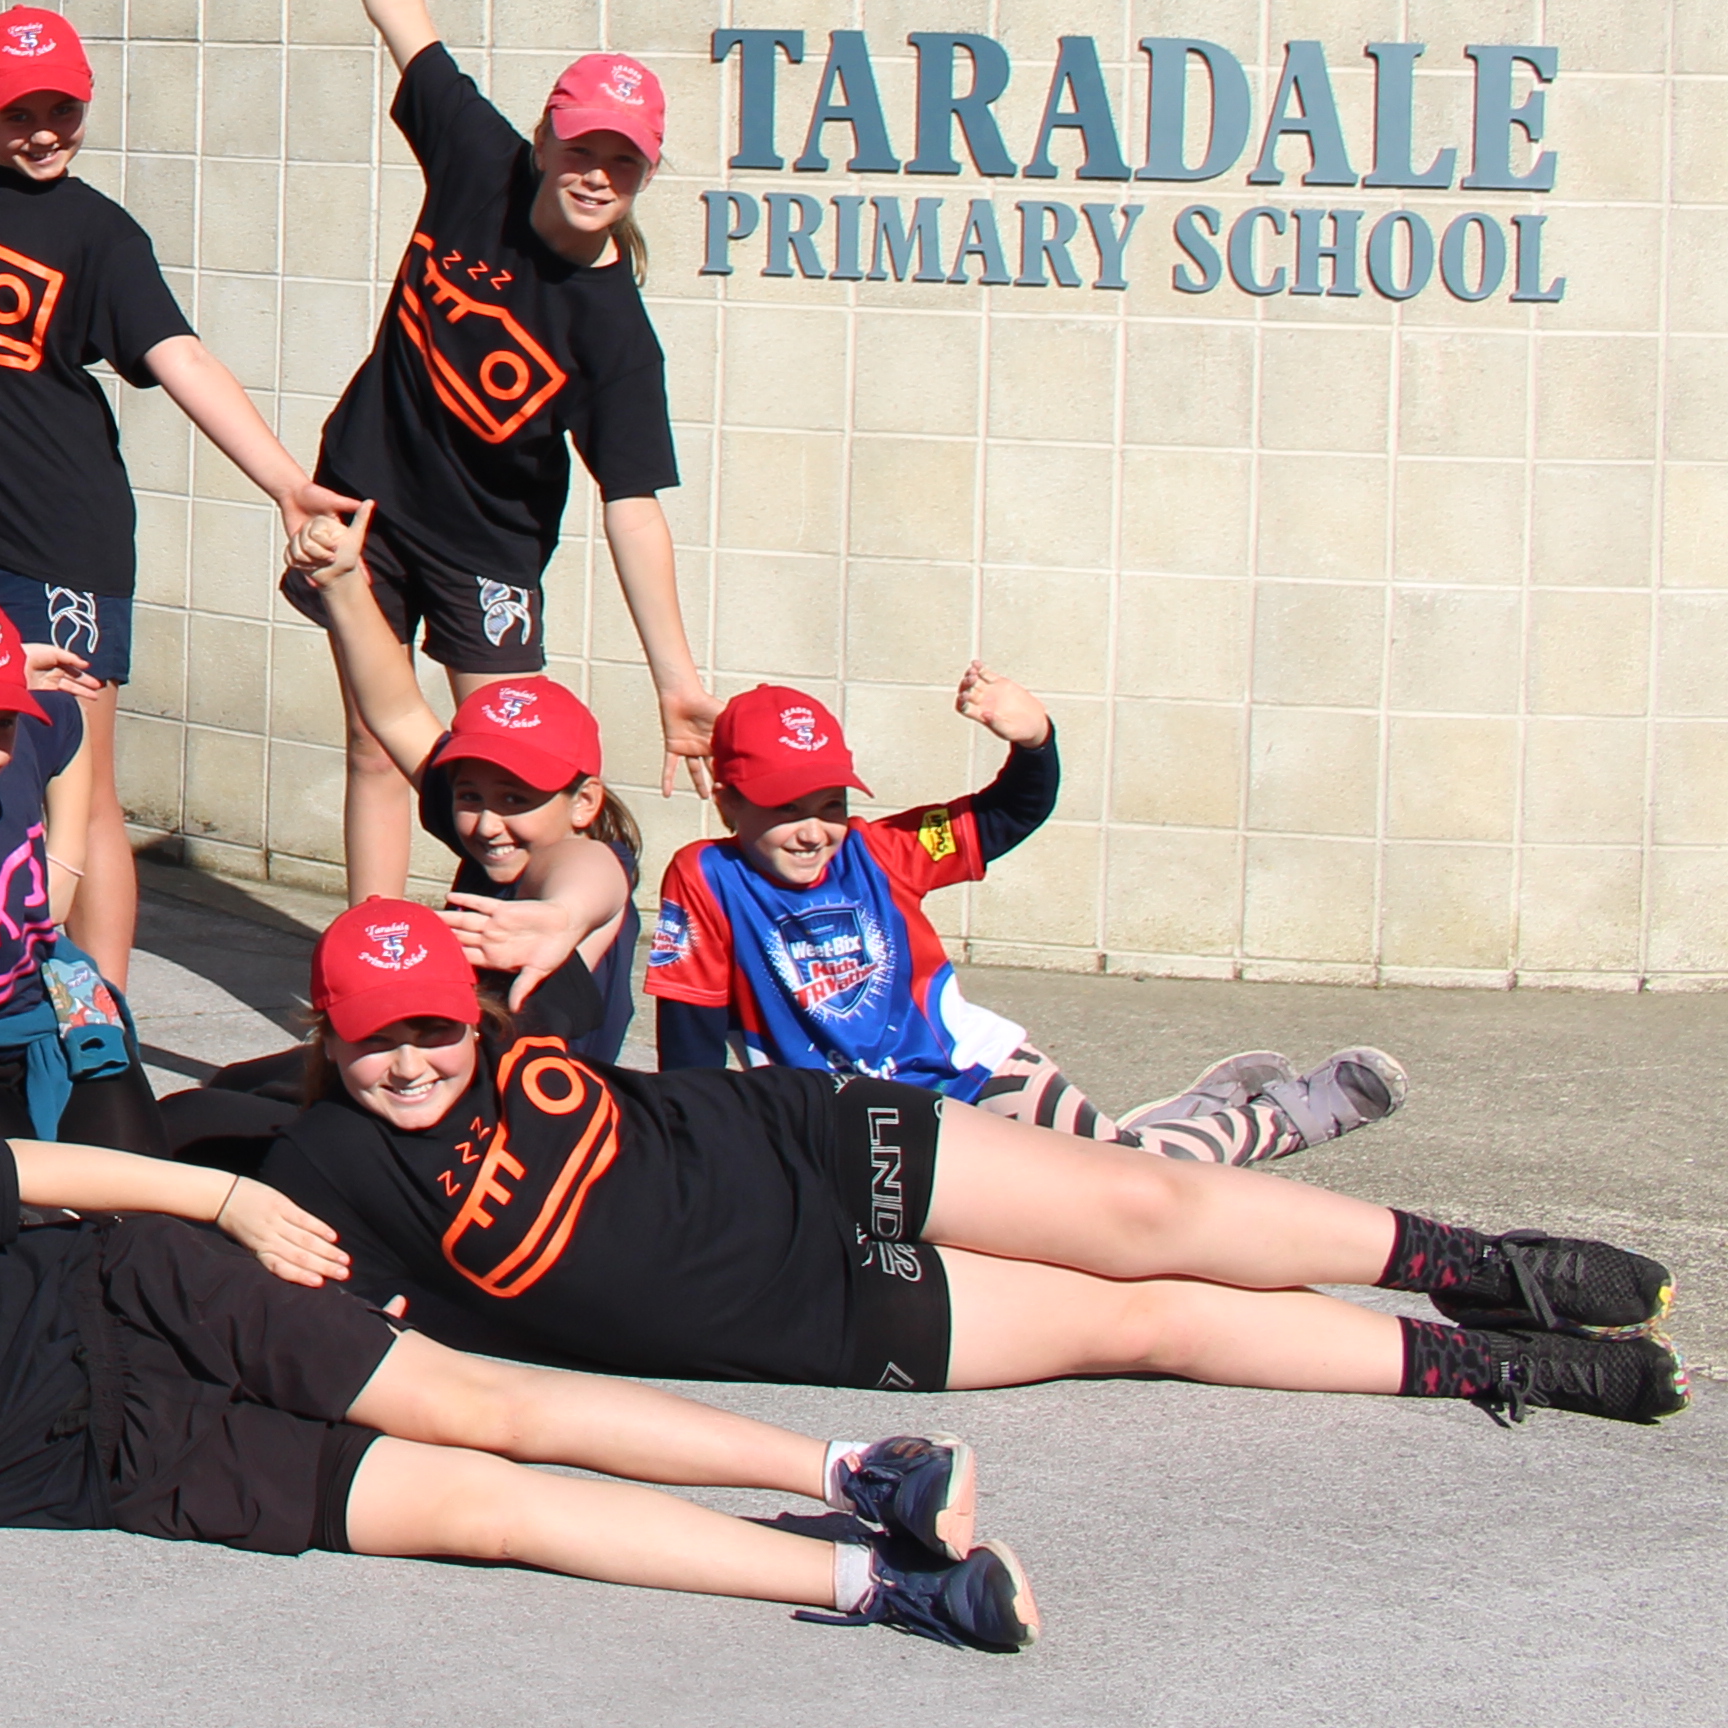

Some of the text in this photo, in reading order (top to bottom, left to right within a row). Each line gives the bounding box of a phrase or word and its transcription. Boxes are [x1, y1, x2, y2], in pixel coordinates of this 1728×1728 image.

[711, 28, 1559, 191] TARADALE
[698, 190, 1566, 303] PRIMARY SCHOOL
[364, 922, 410, 938] Taradale
[358, 944, 428, 971] Primary School
[790, 934, 863, 960] Weet-Bix
[808, 957, 858, 979] Kids
